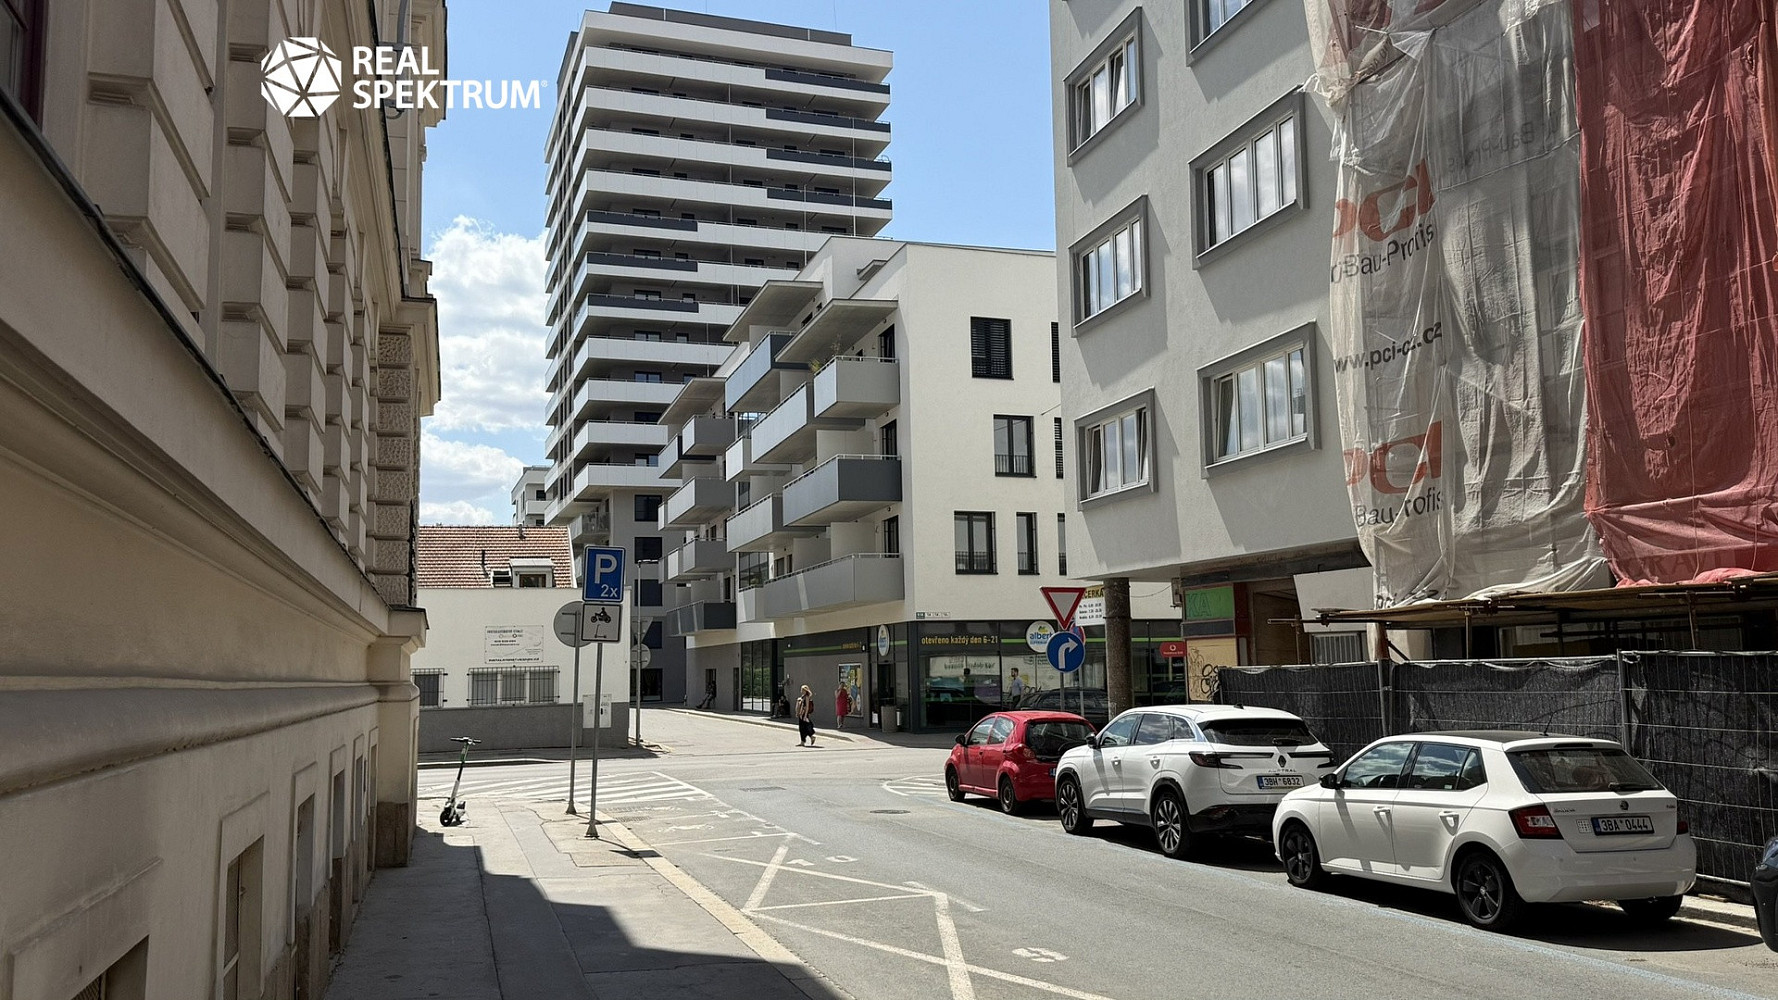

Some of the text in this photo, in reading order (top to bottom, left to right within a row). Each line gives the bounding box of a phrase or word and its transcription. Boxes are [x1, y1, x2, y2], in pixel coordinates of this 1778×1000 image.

[594, 553, 618, 584] P
[600, 584, 618, 598] 2x
[921, 635, 950, 645] otevřeno
[950, 634, 969, 646] každý
[970, 635, 982, 644] den
[1601, 818, 1648, 832] 3BA 0444
